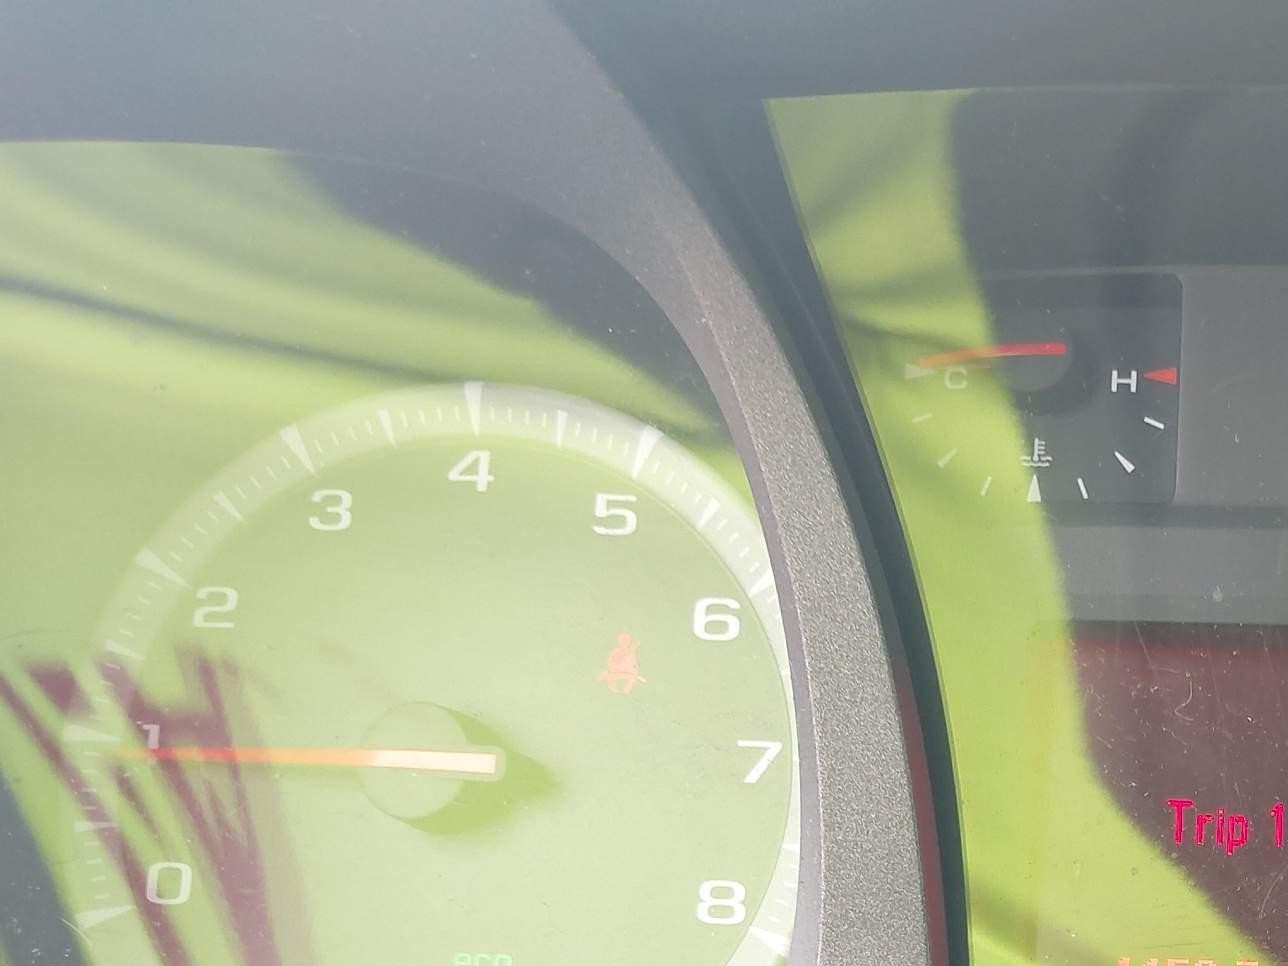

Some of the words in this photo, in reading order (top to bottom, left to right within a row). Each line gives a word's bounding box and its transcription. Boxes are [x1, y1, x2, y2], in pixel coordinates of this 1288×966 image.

[944, 368, 968, 390] C
[1112, 369, 1137, 393] H
[448, 451, 495, 492] 4
[309, 490, 353, 531] 3
[593, 495, 638, 535] 5
[193, 587, 238, 628] 2
[692, 598, 741, 641] 6
[142, 724, 160, 752] 1
[737, 741, 782, 783] 7
[1168, 799, 1248, 855] Trip
[1271, 803, 1285, 848] 1
[147, 862, 192, 904] 0
[697, 881, 746, 925] 8
